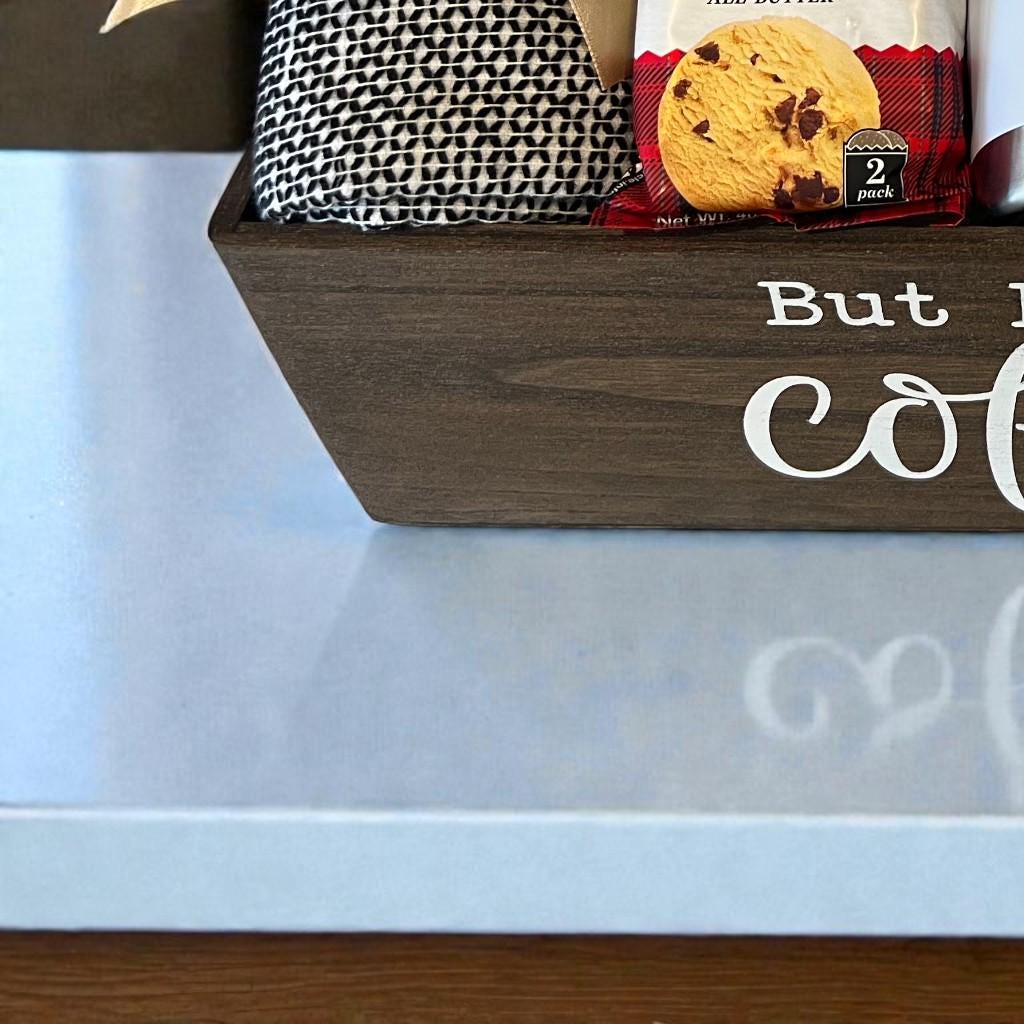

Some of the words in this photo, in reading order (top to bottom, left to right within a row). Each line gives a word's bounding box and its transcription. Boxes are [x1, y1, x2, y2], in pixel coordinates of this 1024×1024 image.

[865, 157, 886, 185] 2
[857, 184, 895, 202] pack
[757, 280, 950, 328] But
